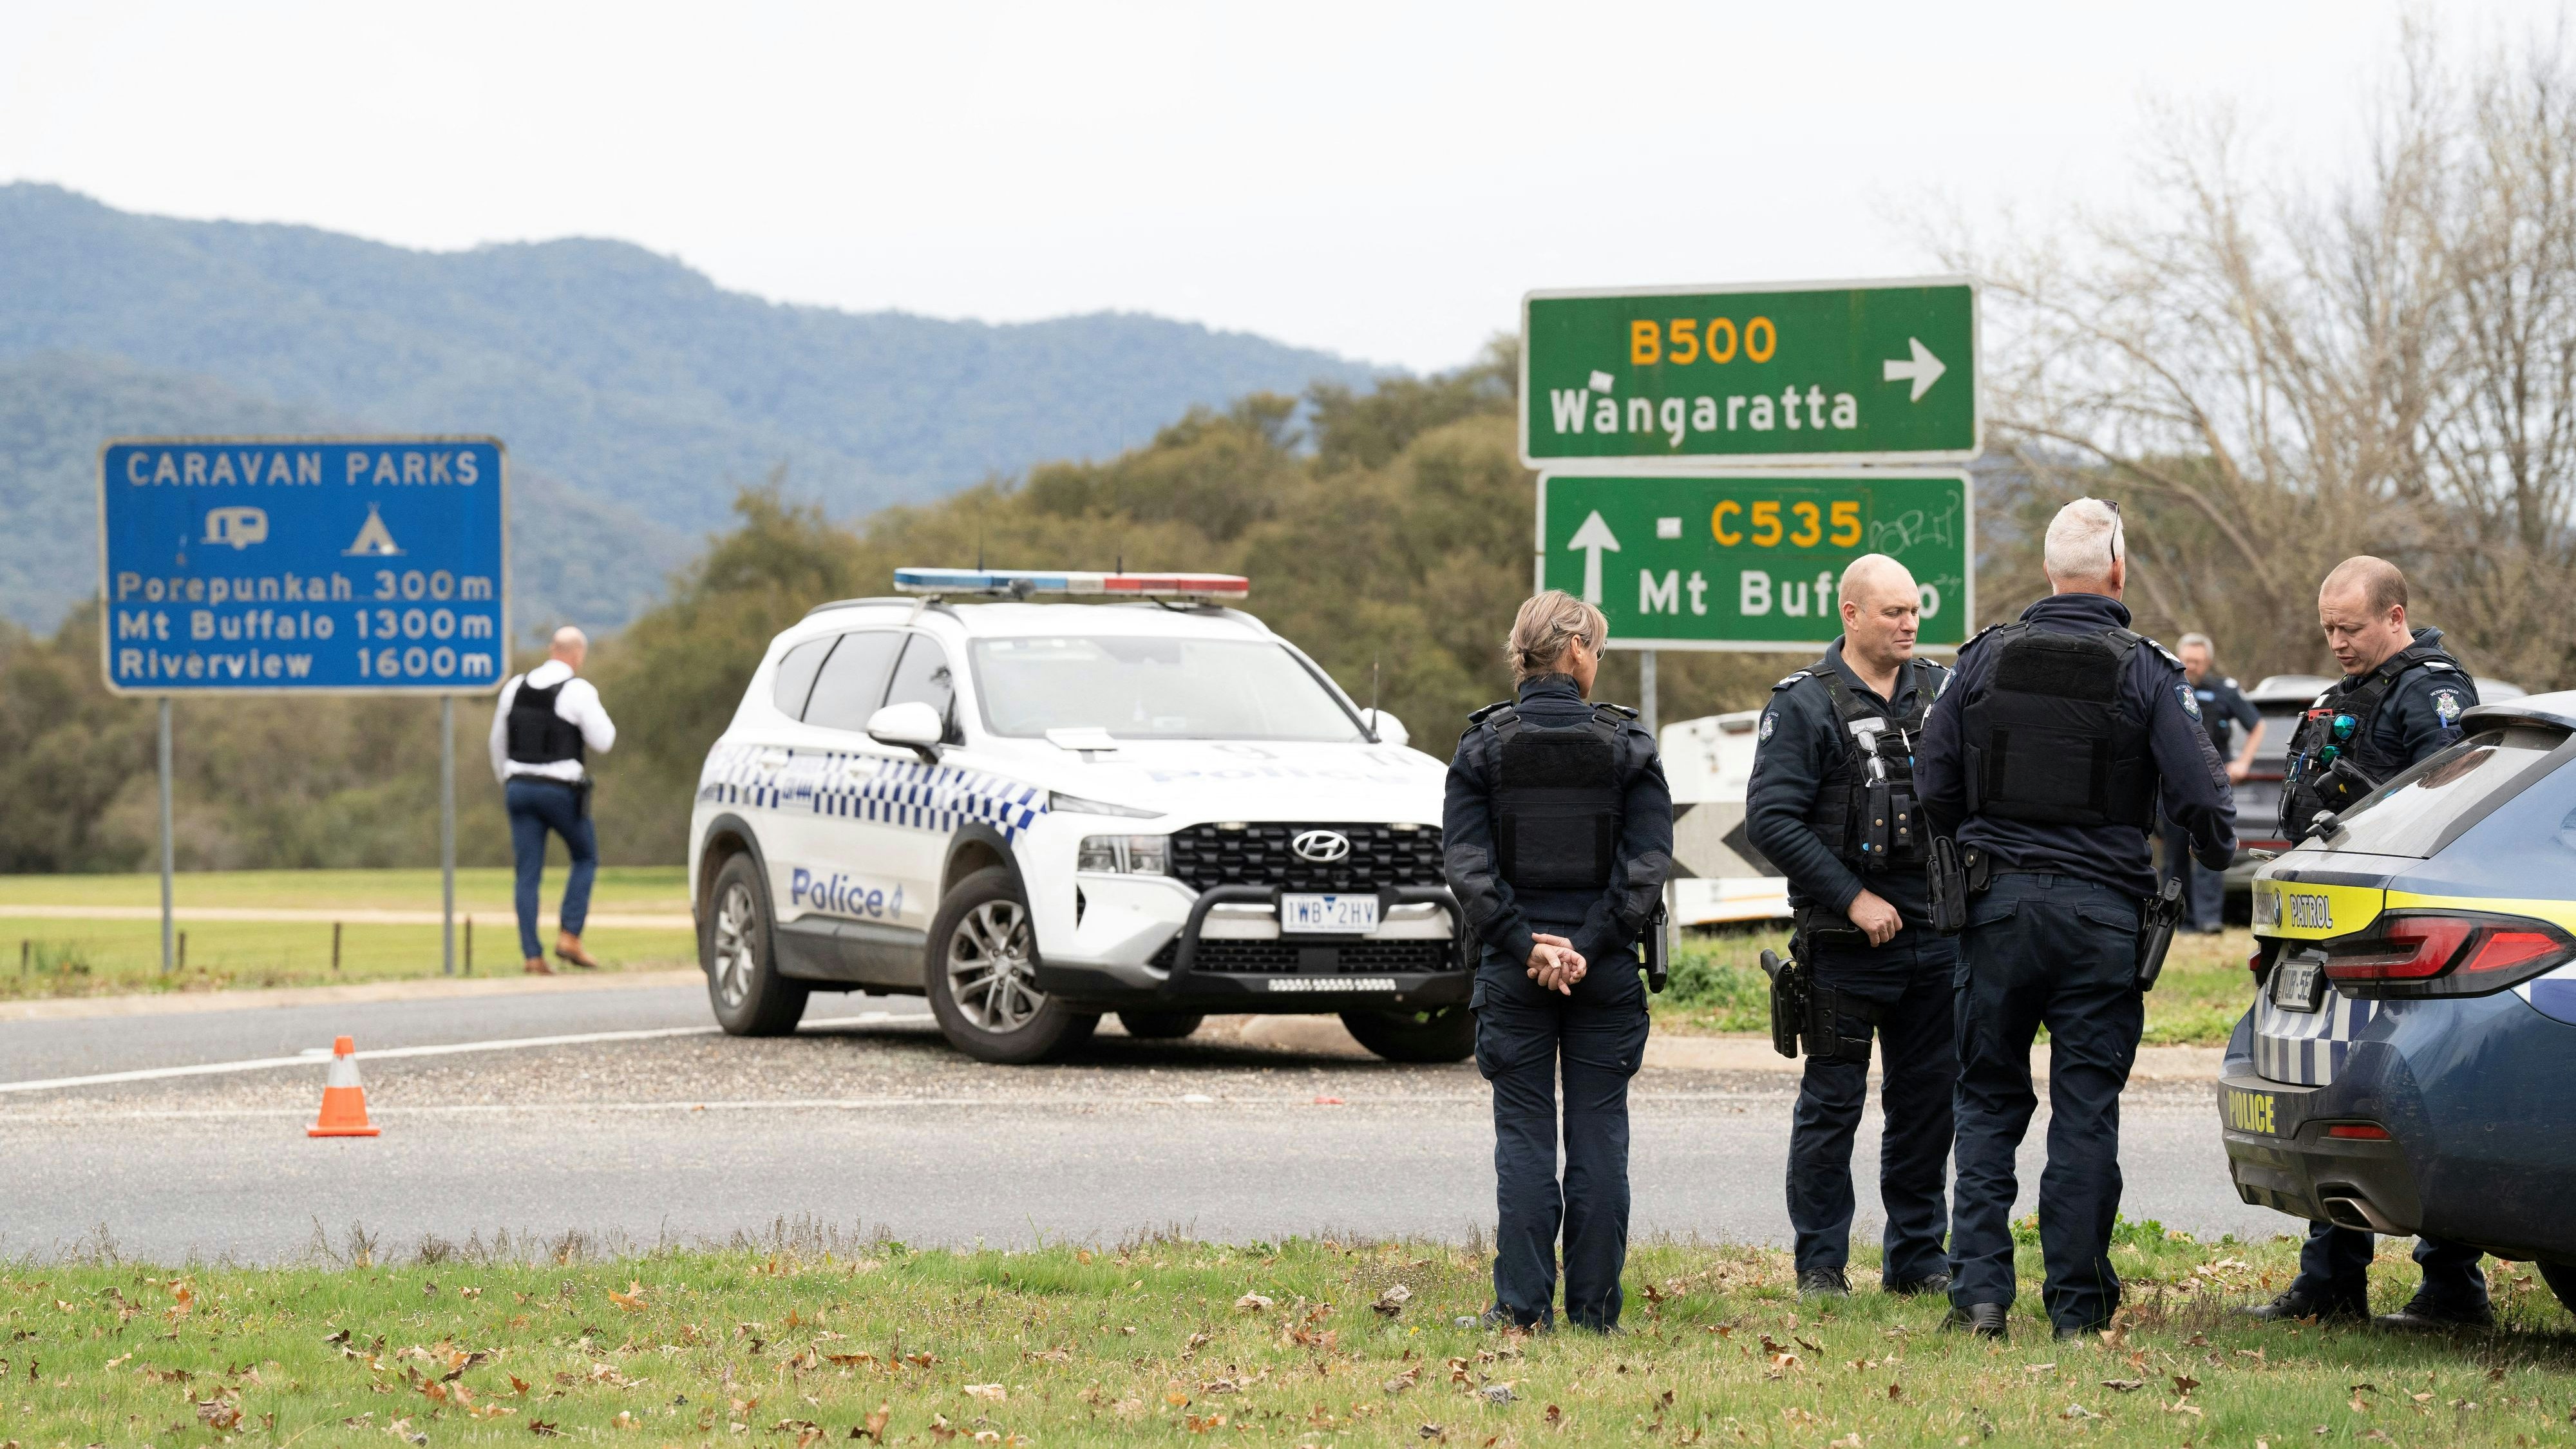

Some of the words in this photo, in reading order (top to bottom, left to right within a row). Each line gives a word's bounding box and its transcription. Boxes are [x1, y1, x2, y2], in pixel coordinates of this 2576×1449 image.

[1631, 316, 1776, 365] B500
[1550, 384, 1857, 447] Wangaratta
[127, 451, 321, 486] CARAVAN
[346, 451, 478, 486] PARKS
[1712, 500, 1862, 547] C535
[117, 571, 352, 606] Porepunkah
[374, 569, 493, 601] 300m
[1640, 569, 1707, 615] Mt
[1741, 570, 1940, 619] Bufo
[118, 610, 169, 640] Mt
[191, 609, 334, 640] Buffalo
[355, 608, 493, 639] 1300m
[119, 648, 313, 679] Riverview
[357, 646, 493, 677] 1600m
[792, 867, 883, 917] Police
[1289, 901, 1321, 923] 1WB
[1338, 902, 1374, 923] 2HV
[2290, 893, 2333, 929] PATROL
[2229, 1090, 2275, 1133] POLICE
